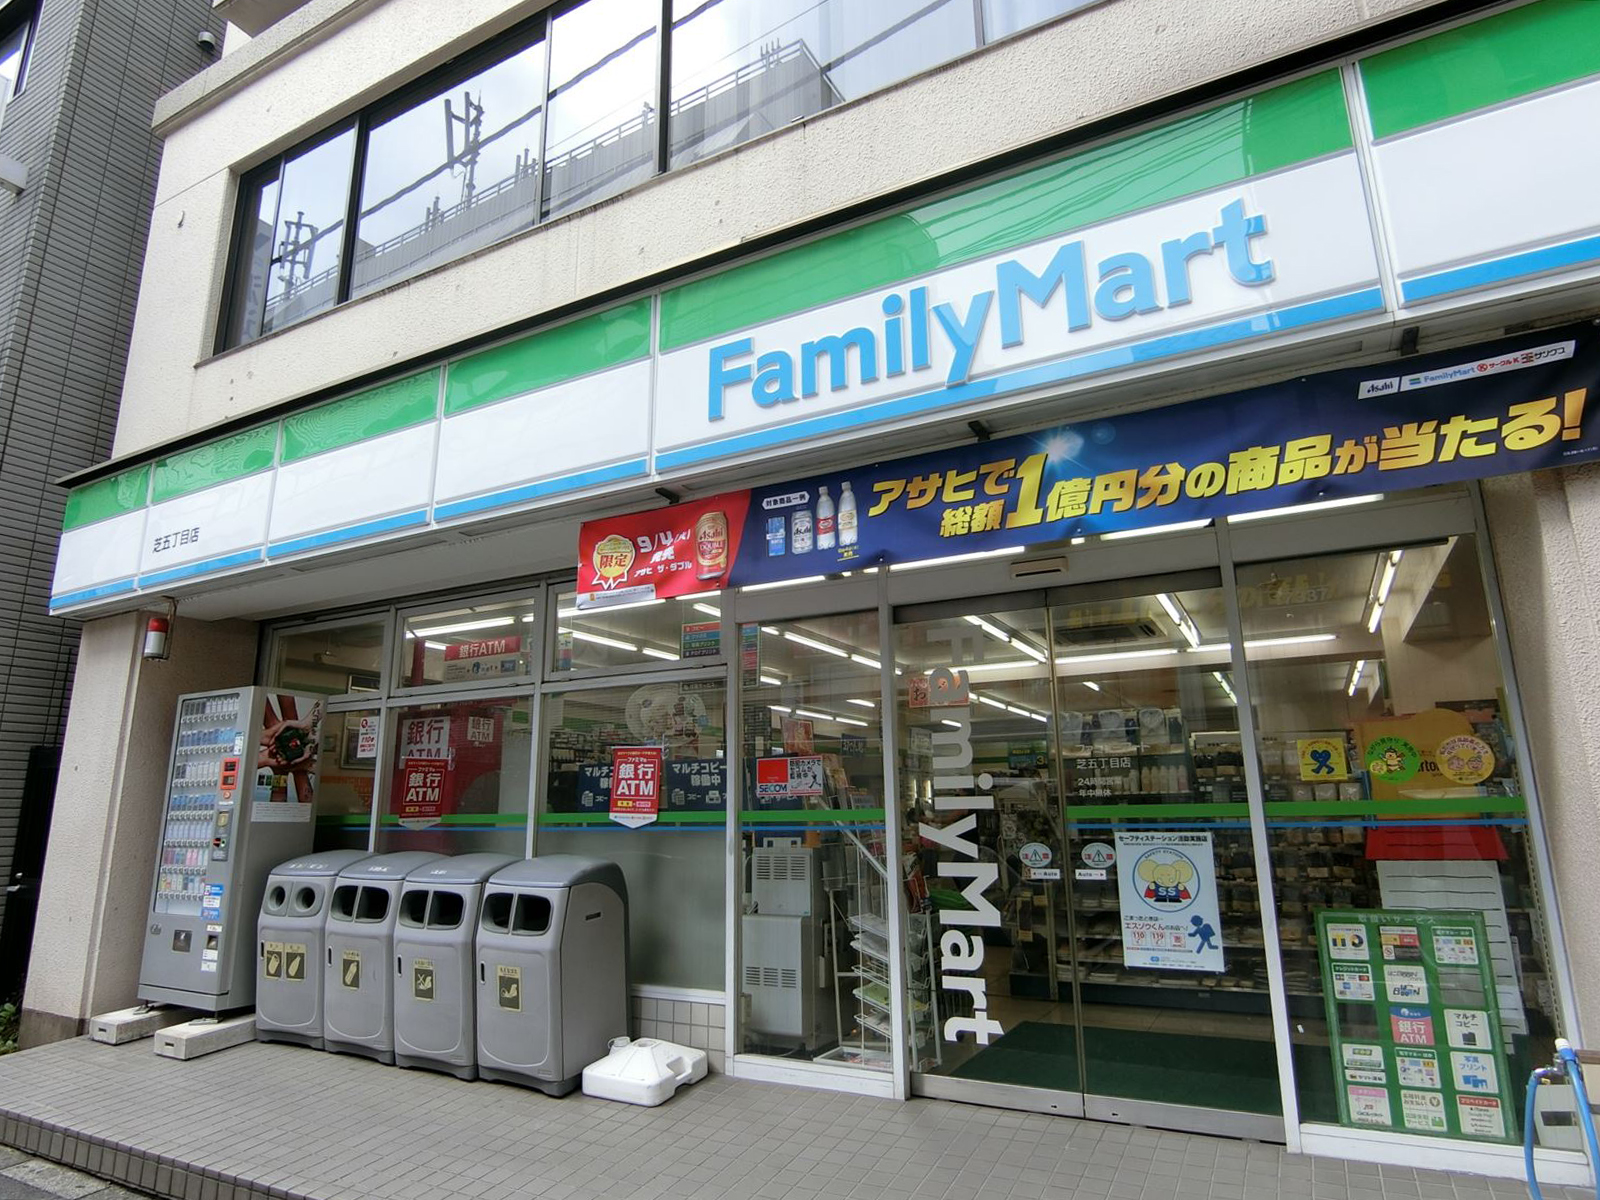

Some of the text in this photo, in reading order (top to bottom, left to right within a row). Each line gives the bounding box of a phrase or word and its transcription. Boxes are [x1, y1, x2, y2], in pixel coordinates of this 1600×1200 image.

[708, 196, 1276, 422] FamilyMart
[1423, 366, 1476, 385] FamilyMart
[1366, 380, 1394, 395] Asahi
[867, 458, 1015, 518] アサヒで
[938, 503, 1003, 539] 総額
[152, 526, 201, 556] 芝五丁目店
[699, 526, 723, 541] Asahi
[599, 553, 629, 569] 限定
[459, 639, 506, 659] 銀行ATM
[406, 718, 445, 746] 銀行
[470, 731, 490, 742] ATM
[672, 761, 727, 775] マルチコピー
[1076, 757, 1131, 770] 芝五丁目店
[618, 763, 655, 780] 銀行
[408, 772, 442, 787] 銀行
[406, 787, 440, 802] ATM
[616, 780, 654, 796] ATM
[758, 783, 788, 793] SECOM
[918, 625, 1005, 1047] FamilyMart
[1158, 886, 1176, 897] SS
[1454, 1012, 1478, 1021] マルチ
[1455, 1020, 1479, 1028] コピー
[1397, 1020, 1426, 1034] 銀行
[1400, 1033, 1428, 1044] ATM
[1459, 1063, 1488, 1072] プリント
